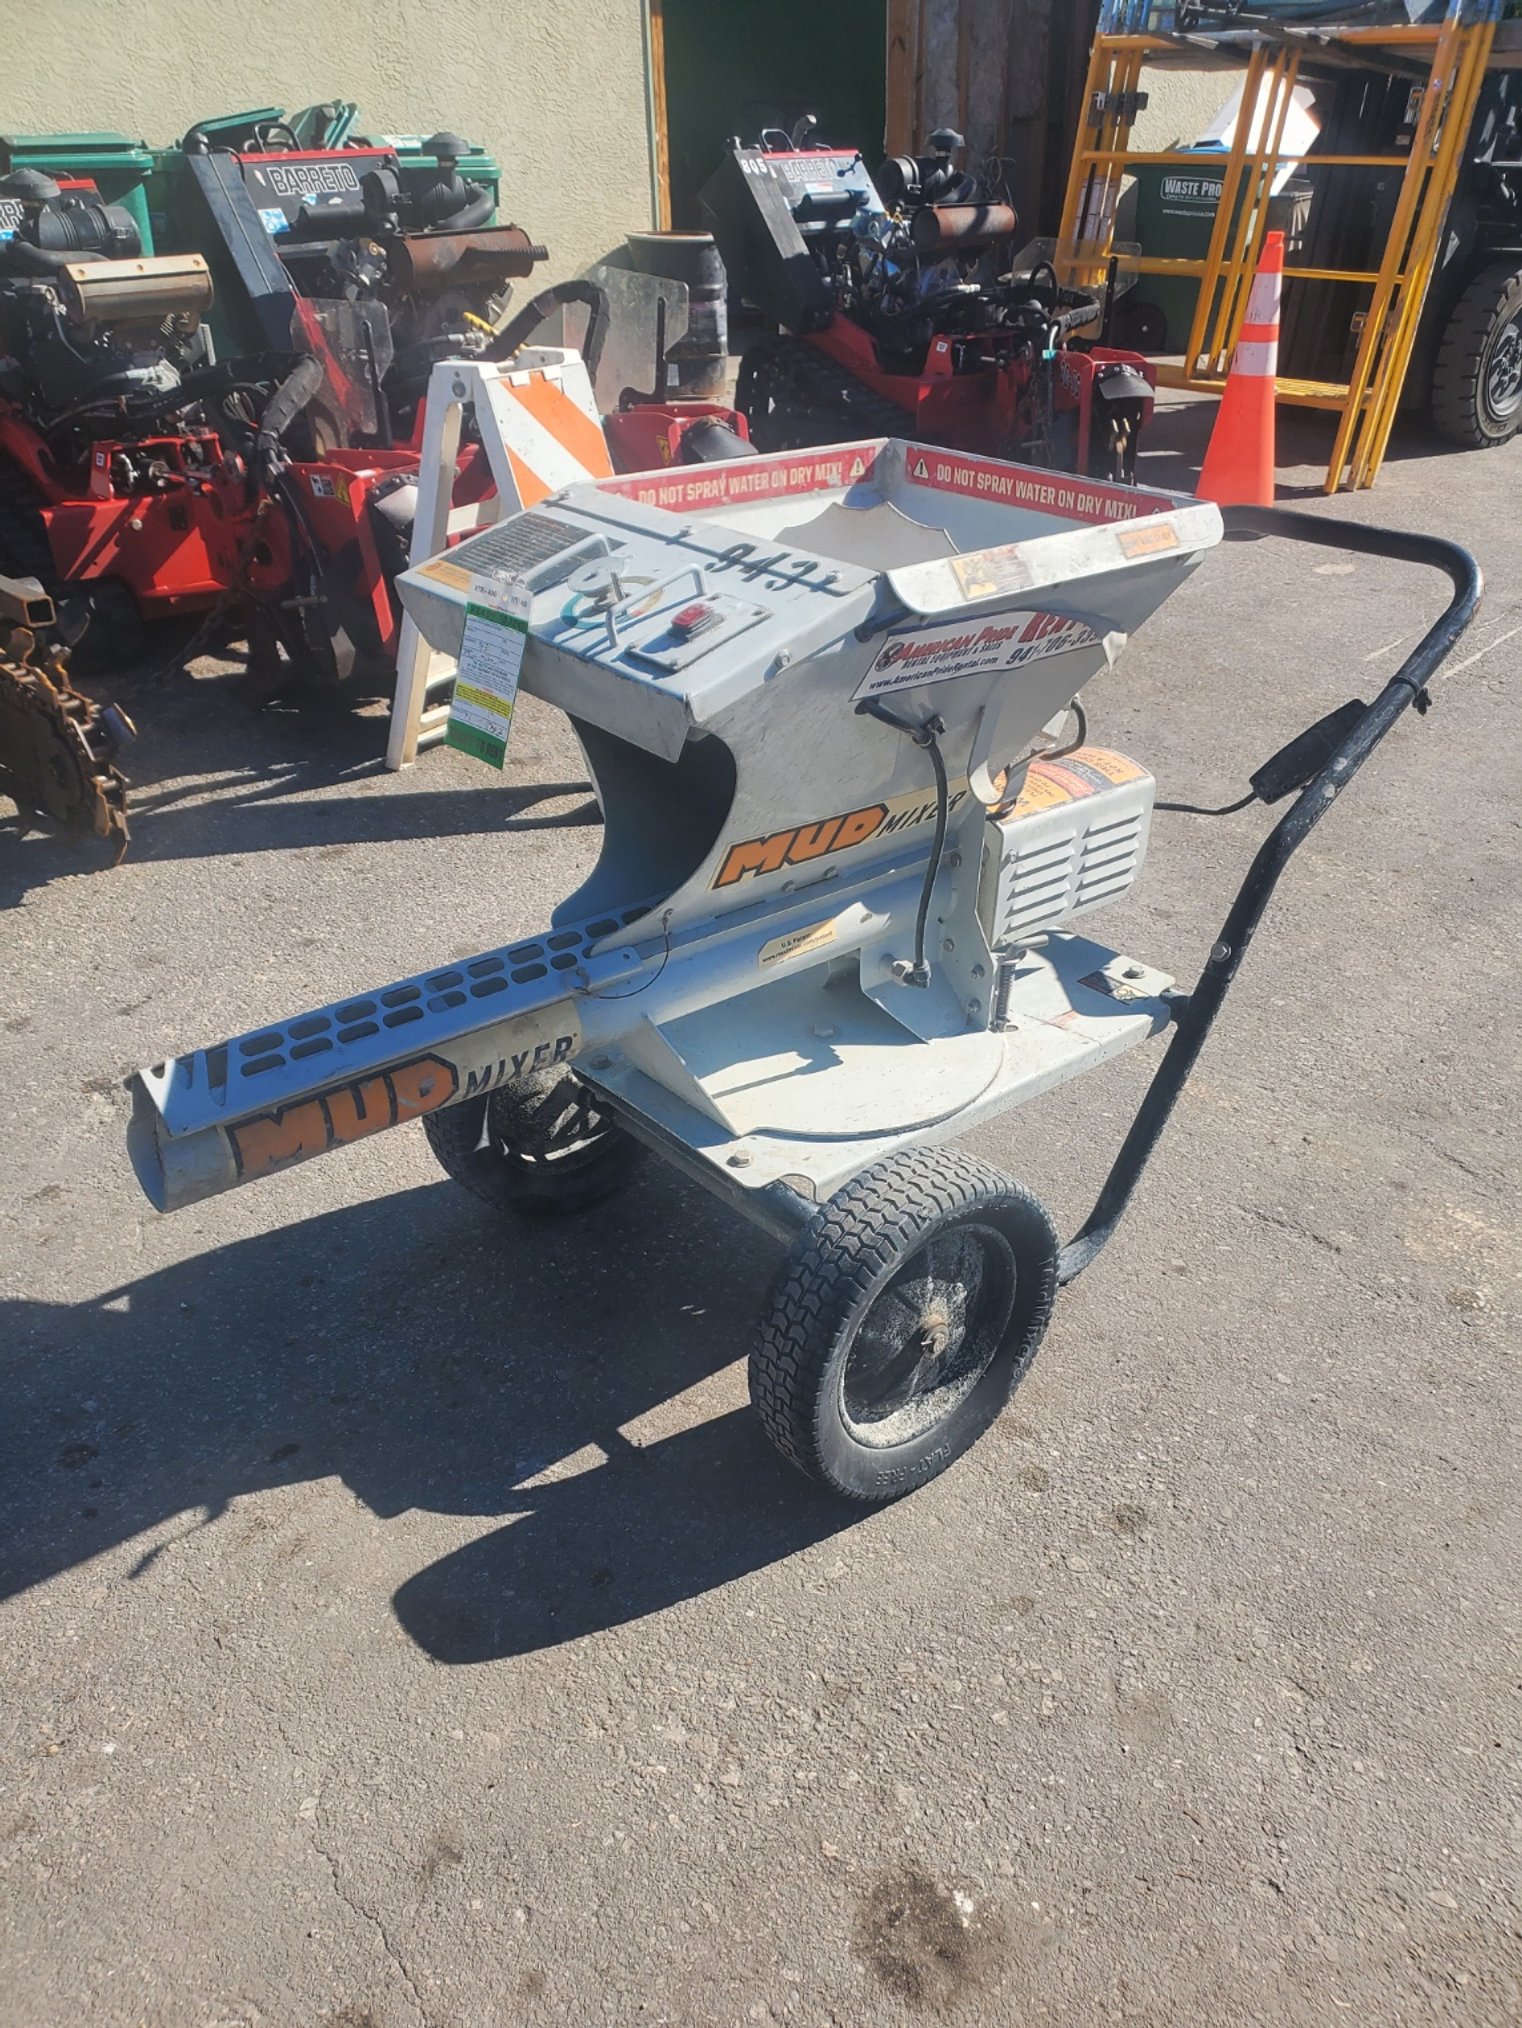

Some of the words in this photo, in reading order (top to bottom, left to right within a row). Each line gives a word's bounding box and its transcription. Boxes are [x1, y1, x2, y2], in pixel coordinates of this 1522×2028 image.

[266, 163, 361, 196] BARRETO
[1164, 179, 1200, 197] WASTE
[1200, 181, 1223, 198] PRO
[638, 489, 657, 506] DO
[658, 484, 685, 506] NOT
[686, 477, 728, 502] SPRAY
[727, 471, 771, 495] WATER
[770, 468, 788, 488] ON
[789, 464, 814, 486] DRY
[936, 463, 952, 483] DO
[952, 466, 976, 489] NOT
[976, 471, 1014, 497] SPRAY
[1015, 479, 1056, 506] WATER
[1057, 489, 1075, 510] ON
[1075, 492, 1103, 516] DRY
[1104, 498, 1137, 520] MIX!
[889, 633, 977, 662] AMERICAN
[974, 624, 1019, 647] PRIDE
[710, 802, 890, 890] MUD
[223, 1051, 460, 1179] MUD
[460, 1035, 573, 1100] MIXER
